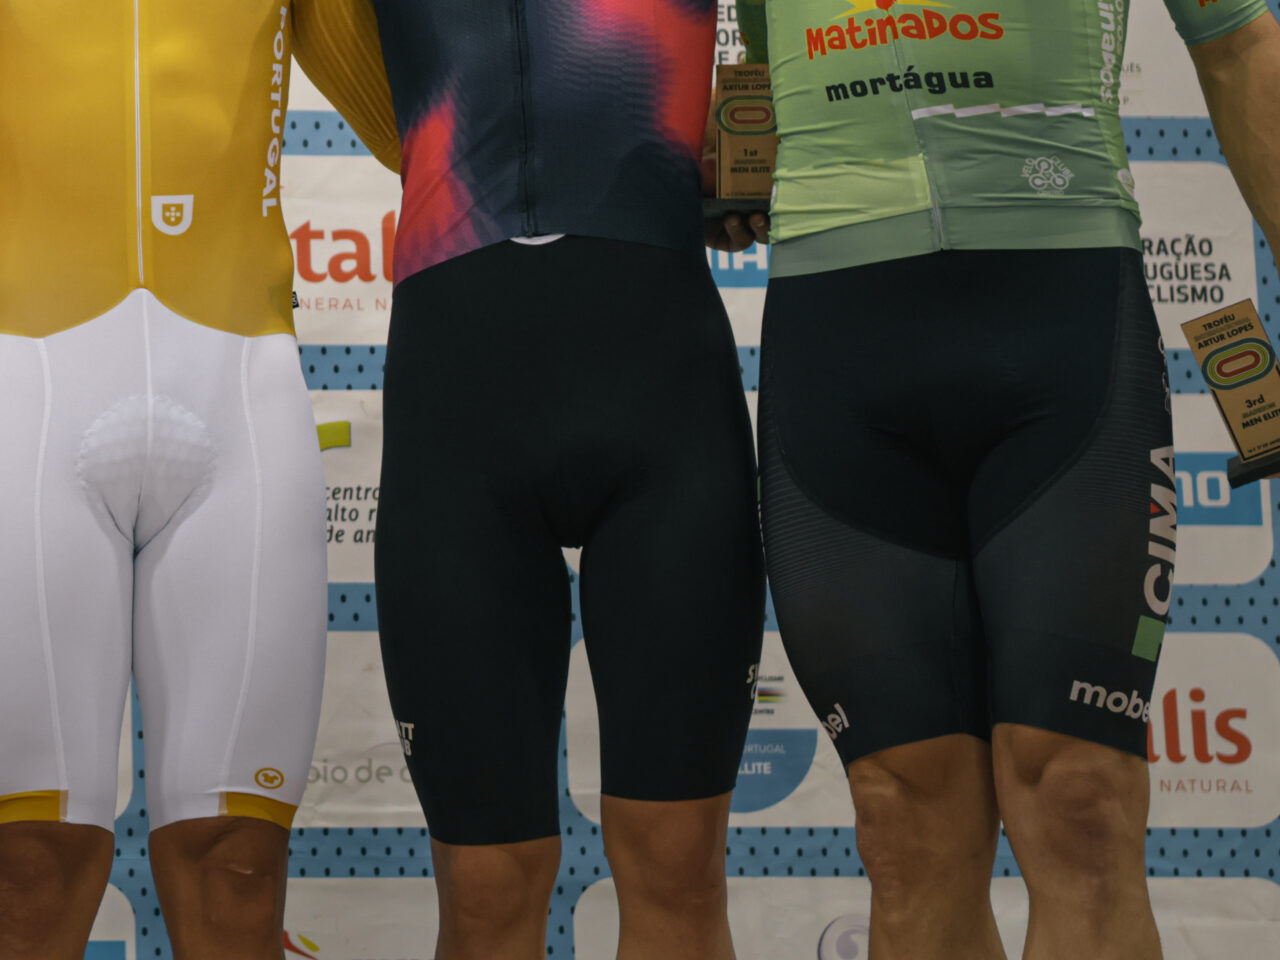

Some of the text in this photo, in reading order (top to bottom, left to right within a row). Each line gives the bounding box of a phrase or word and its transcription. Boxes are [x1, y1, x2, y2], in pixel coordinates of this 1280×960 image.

[825, 65, 995, 102] mortágua
[261, 6, 288, 218] PORTUGAL
[1142, 234, 1213, 261] RAÇÃO
[1145, 262, 1232, 282] UGUESA
[300, 297, 365, 311] NERAL
[1197, 333, 1227, 350] ARTUR
[1227, 322, 1254, 338] LOPES
[1245, 394, 1265, 409] 3rd
[1242, 417, 1263, 430] MEN
[1263, 408, 1280, 423] ELIT
[1144, 445, 1177, 616] CIMA
[1069, 679, 1151, 724] mobe
[744, 743, 786, 754] RTUGAL
[354, 758, 393, 784] de
[1159, 778, 1254, 793] NATURAL
